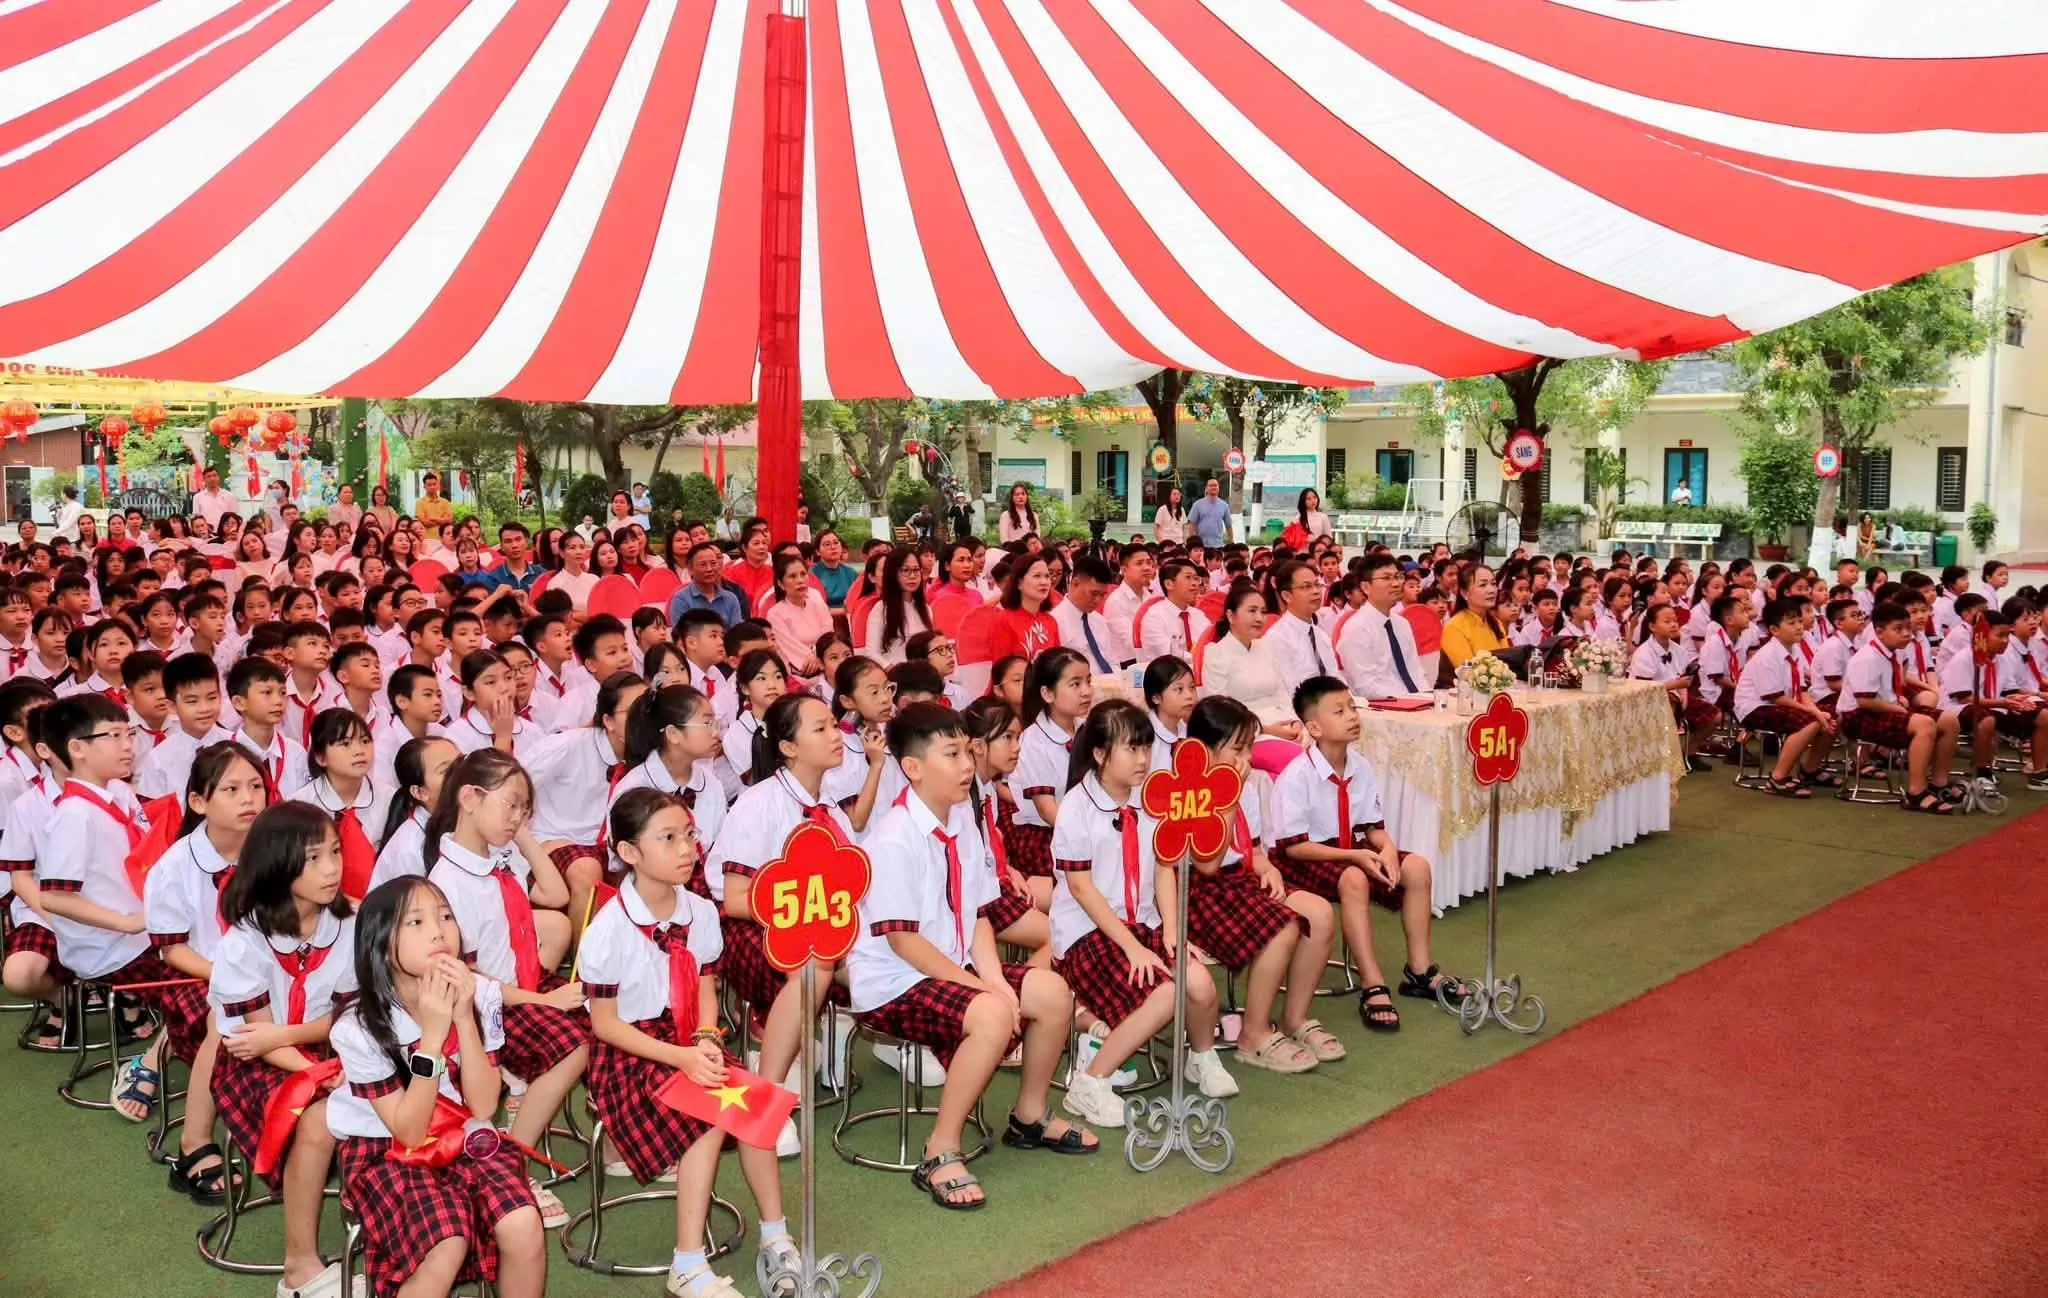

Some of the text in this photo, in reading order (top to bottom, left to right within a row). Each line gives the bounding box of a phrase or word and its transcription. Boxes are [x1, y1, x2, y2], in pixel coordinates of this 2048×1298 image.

[1479, 725, 1516, 761] 5A1
[1169, 788, 1212, 821] 5A2
[772, 873, 851, 929] 5A3
